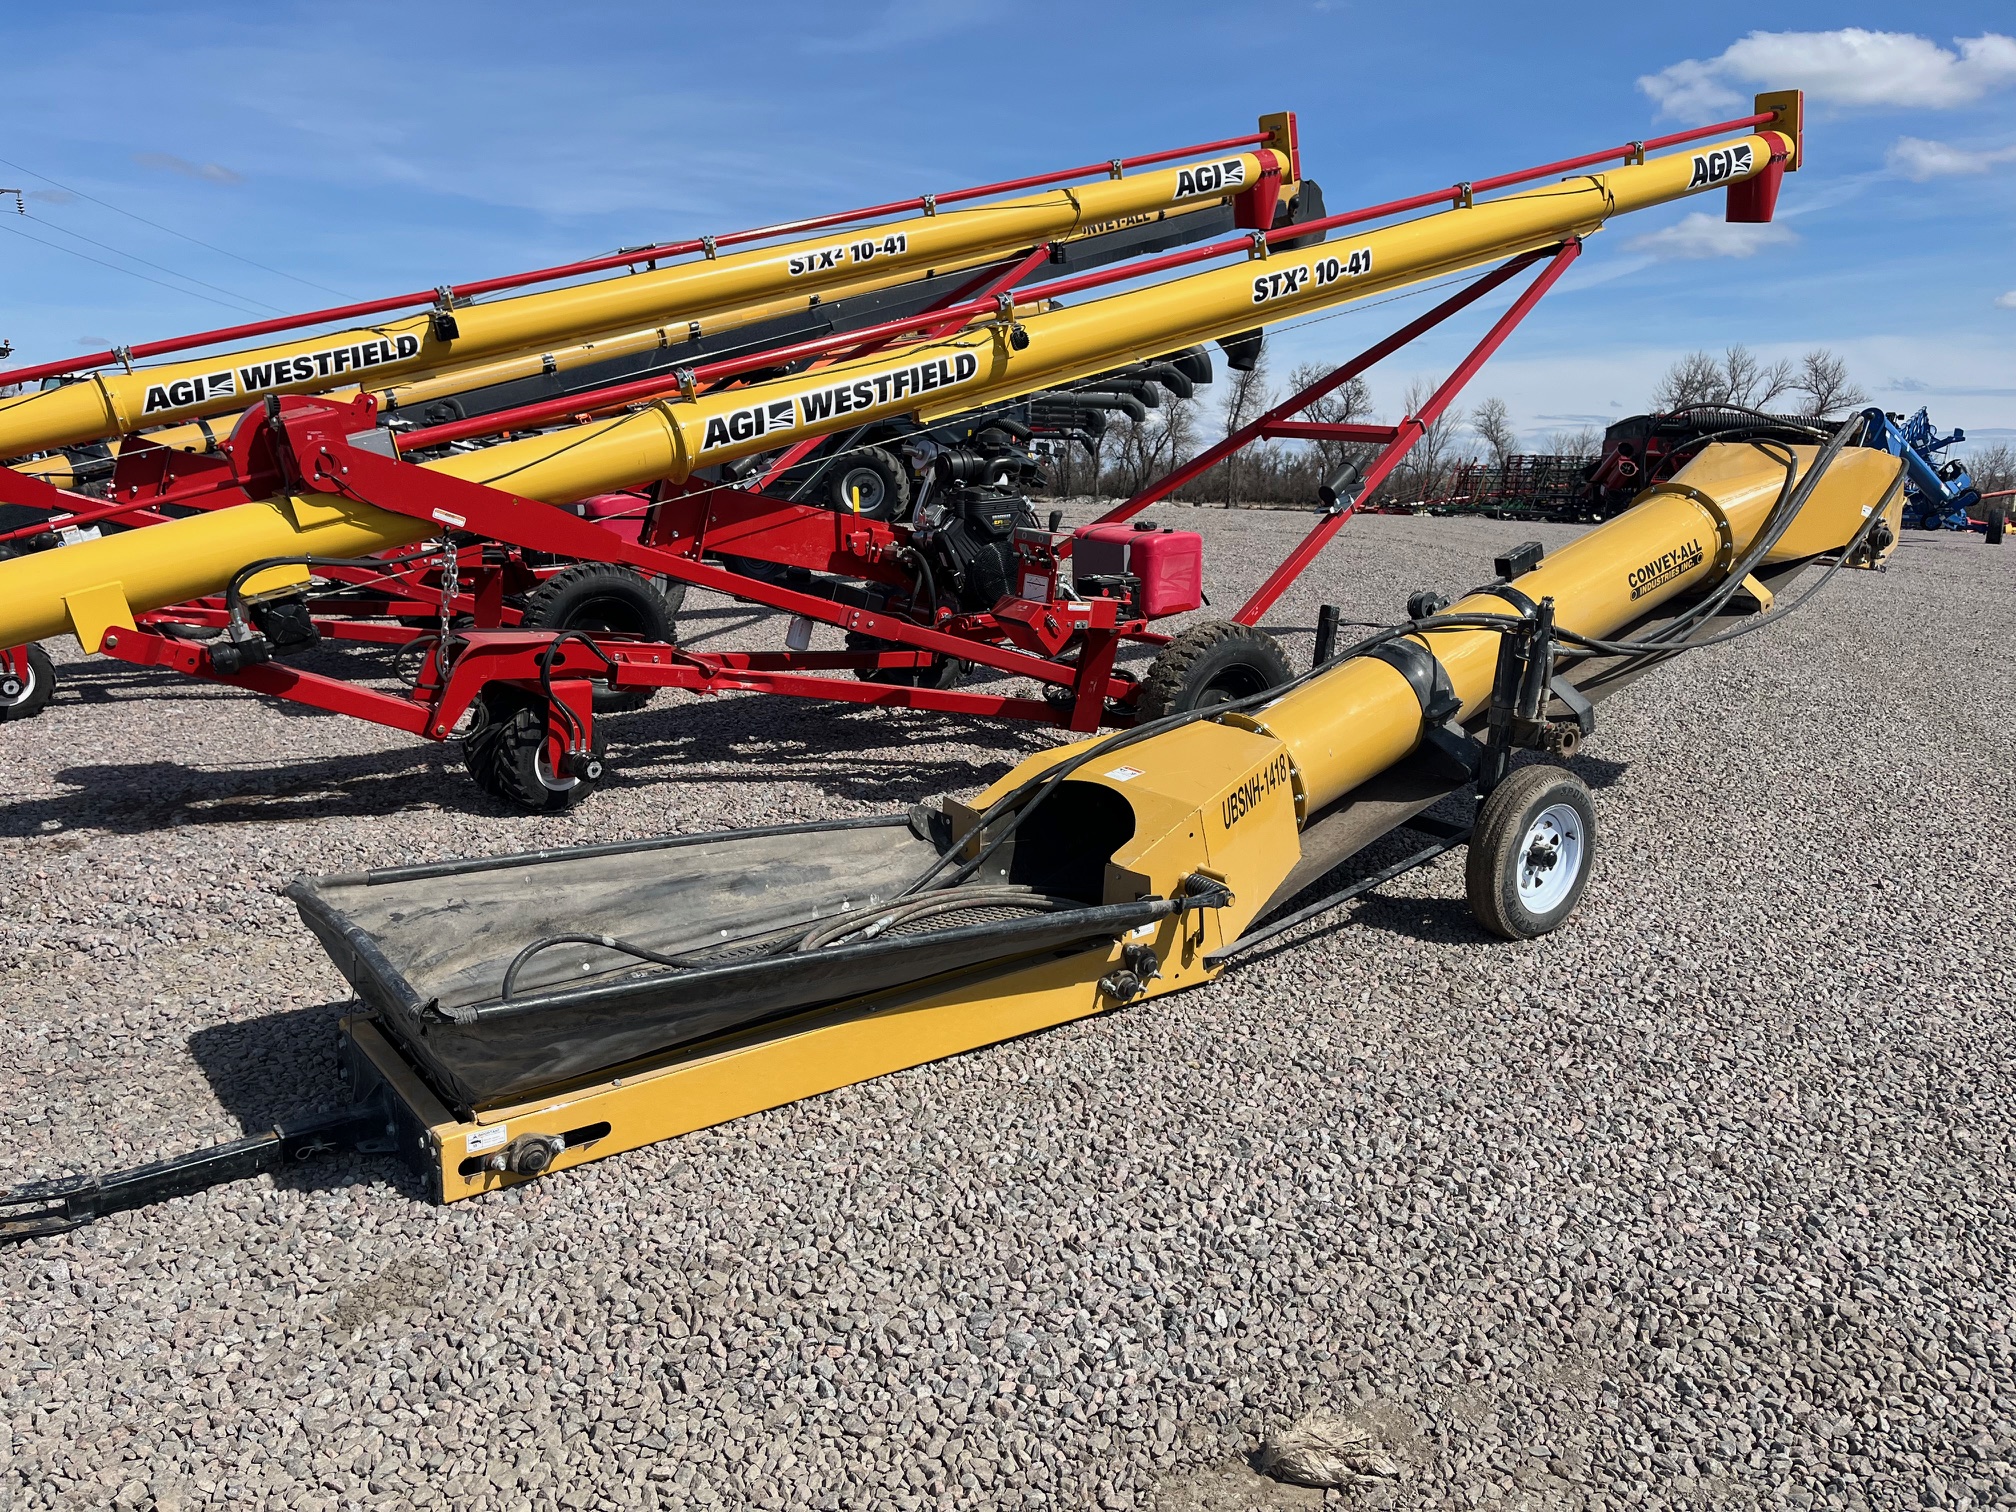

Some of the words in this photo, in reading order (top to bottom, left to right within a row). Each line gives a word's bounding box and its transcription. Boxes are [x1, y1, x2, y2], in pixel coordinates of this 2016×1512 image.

[1175, 164, 1222, 198] AGI
[1688, 149, 1733, 188] AGI
[1081, 213, 1151, 235] NVEY-ALL
[850, 233, 906, 262] 10-41
[1315, 249, 1371, 285] 10-41
[145, 378, 206, 413] AGI
[239, 334, 419, 391] WESTFIELD
[702, 406, 765, 450] AGI
[800, 352, 978, 424] WESTFIELD
[1628, 538, 1703, 588] CONVEY-ALL
[1638, 566, 1680, 596] INDUSTRIES
[1680, 559, 1696, 575] INC.
[1222, 753, 1287, 830] UBSNH-1418
[1559, 786, 1589, 808] SPORT
